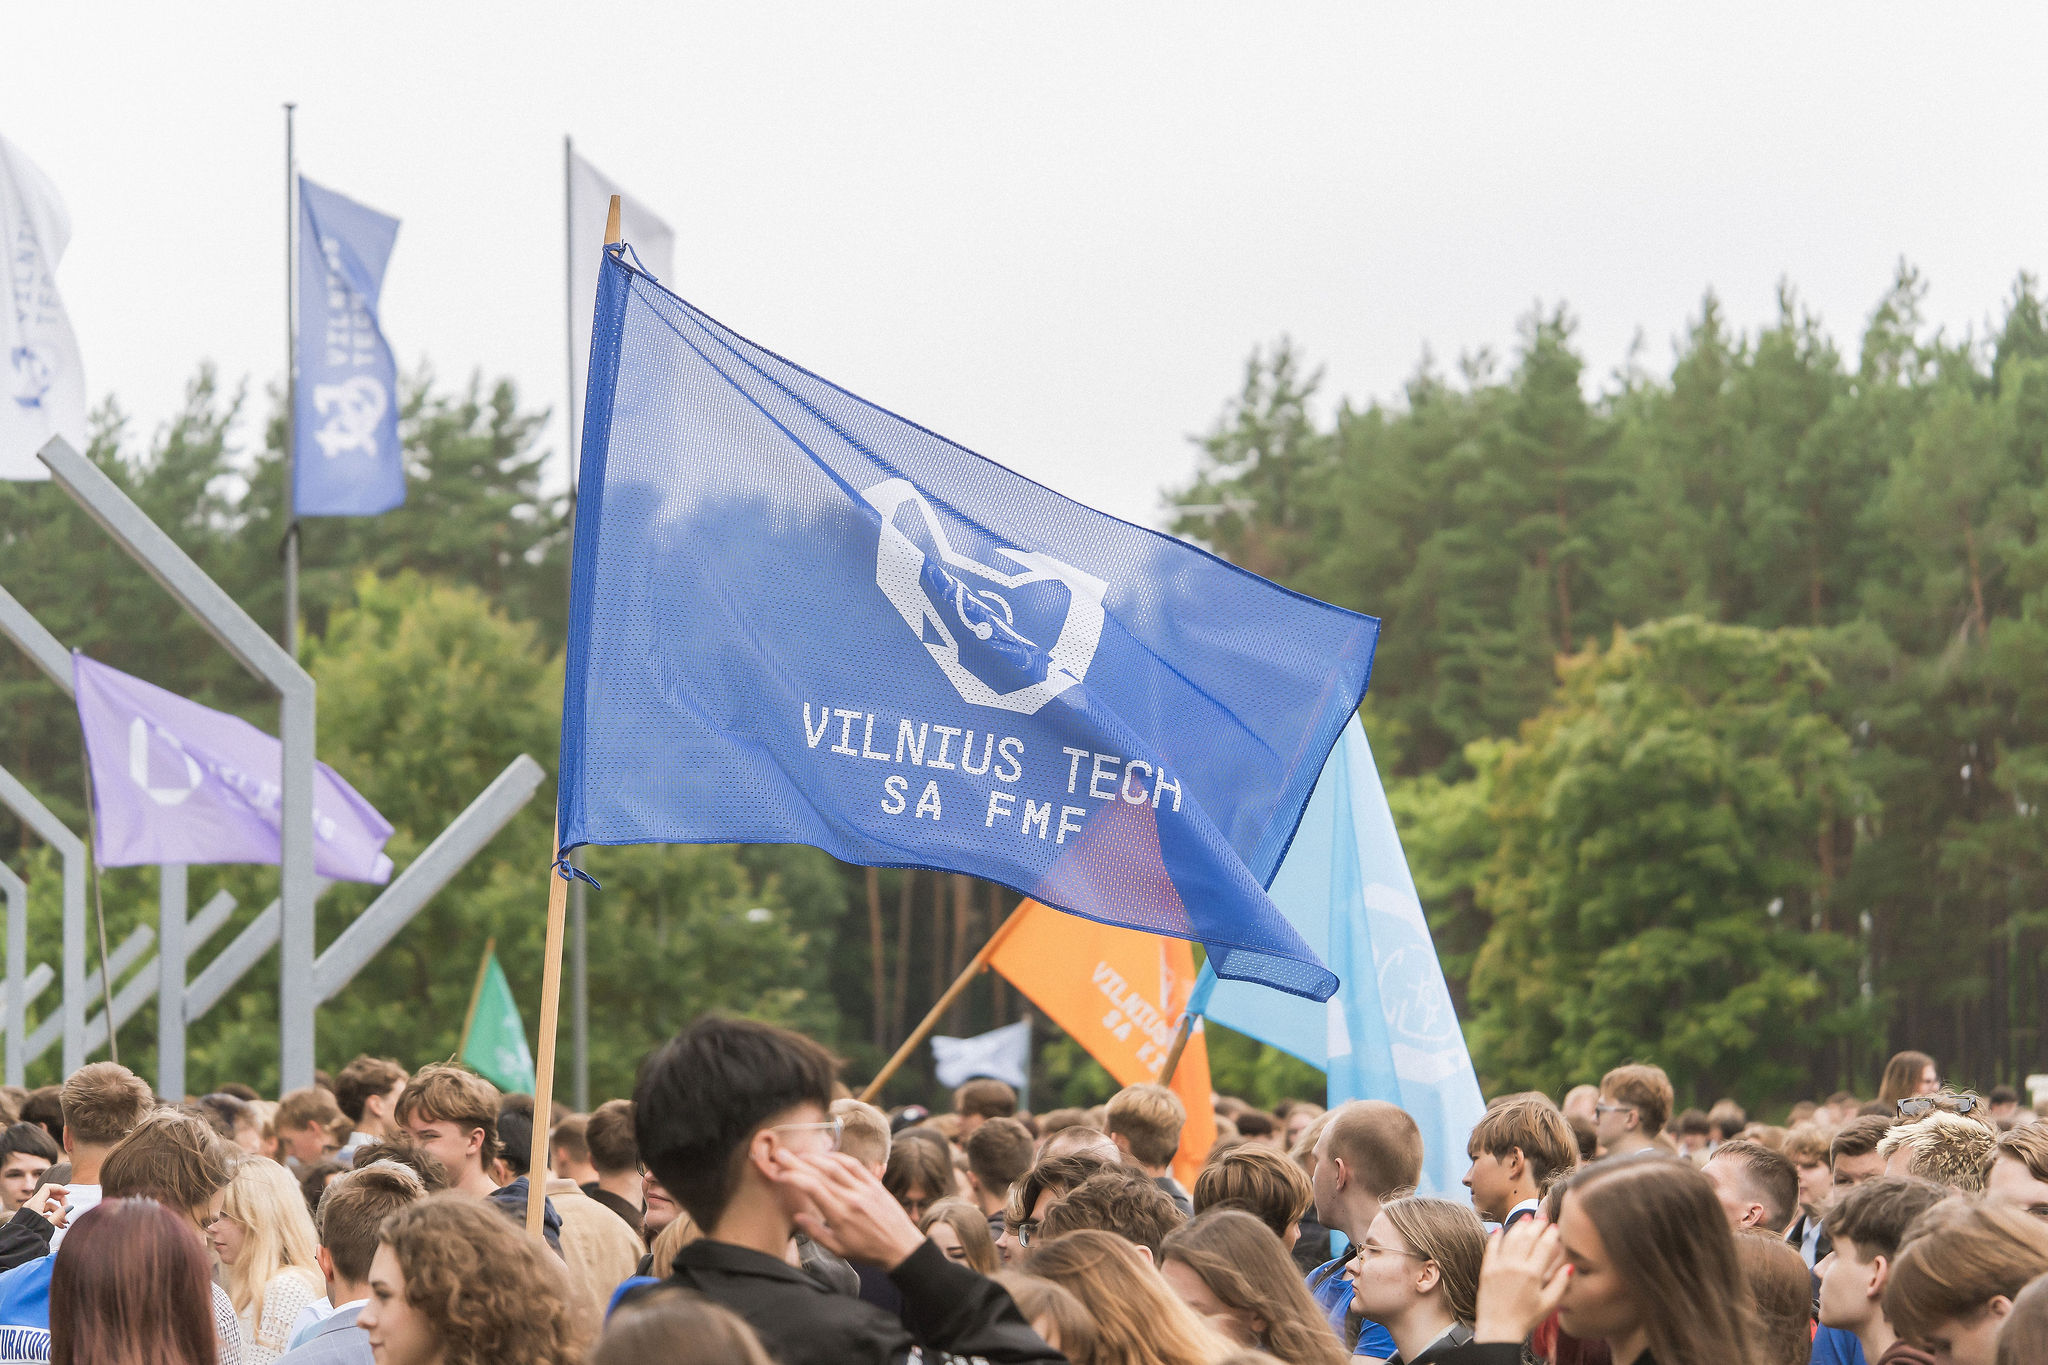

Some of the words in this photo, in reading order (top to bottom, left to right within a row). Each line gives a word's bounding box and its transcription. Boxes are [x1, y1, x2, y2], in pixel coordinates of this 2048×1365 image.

[802, 701, 1025, 783] VILNIUS
[1062, 746, 1182, 813] TECH
[880, 775, 942, 821] SA
[985, 789, 1087, 845] FMF
[1091, 960, 1167, 1046] VILNIUS
[1102, 1009, 1132, 1043] SA
